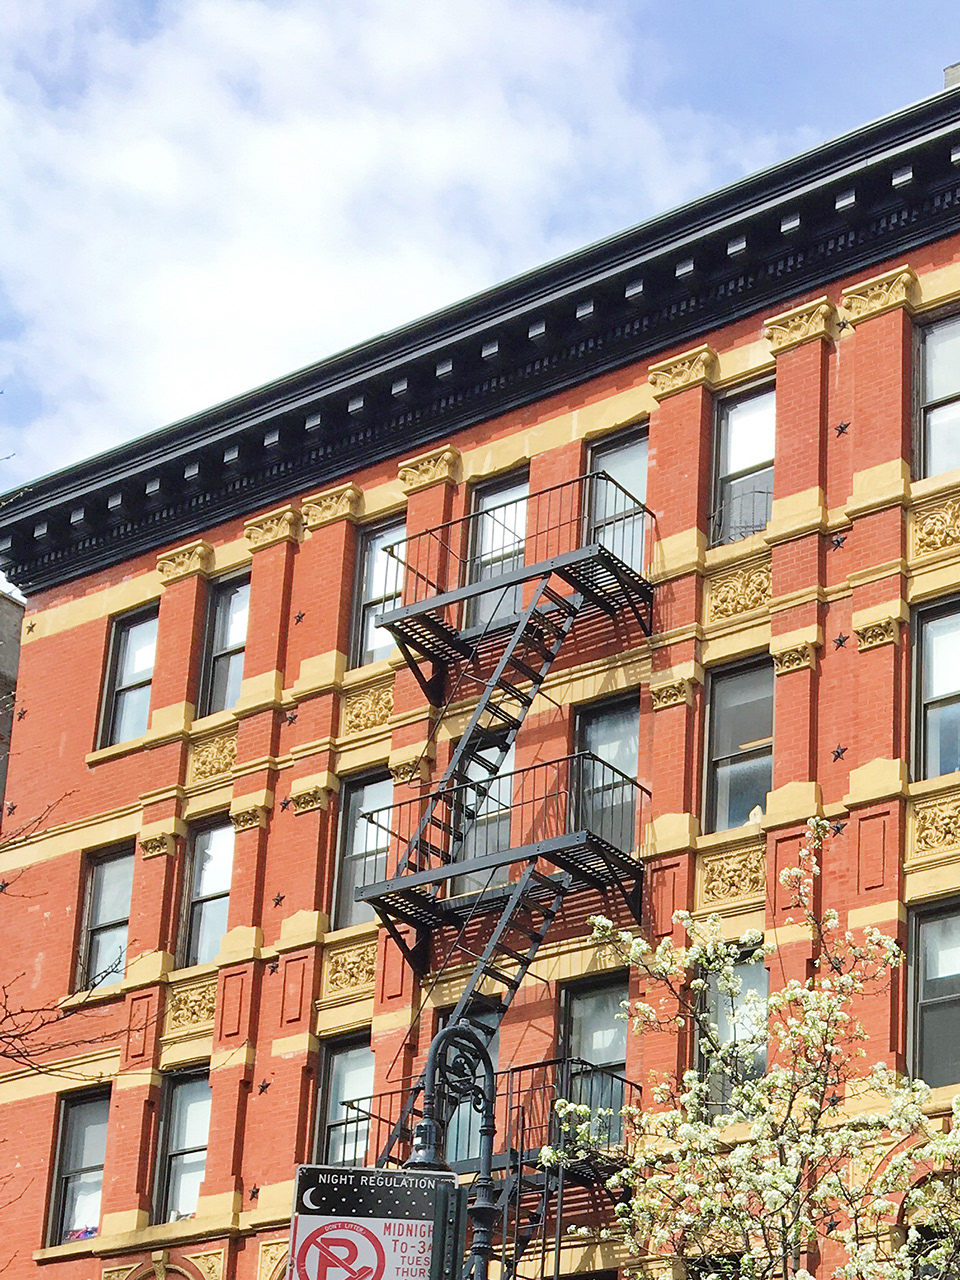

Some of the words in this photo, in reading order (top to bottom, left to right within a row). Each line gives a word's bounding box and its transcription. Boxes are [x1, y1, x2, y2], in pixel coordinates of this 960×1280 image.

[318, 1174, 355, 1186] NIGHT
[360, 1176, 436, 1190] REGULATION
[324, 1222, 342, 1232] DON'T
[383, 1222, 434, 1238] MIDNIGH
[400, 1255, 430, 1266] TUES
